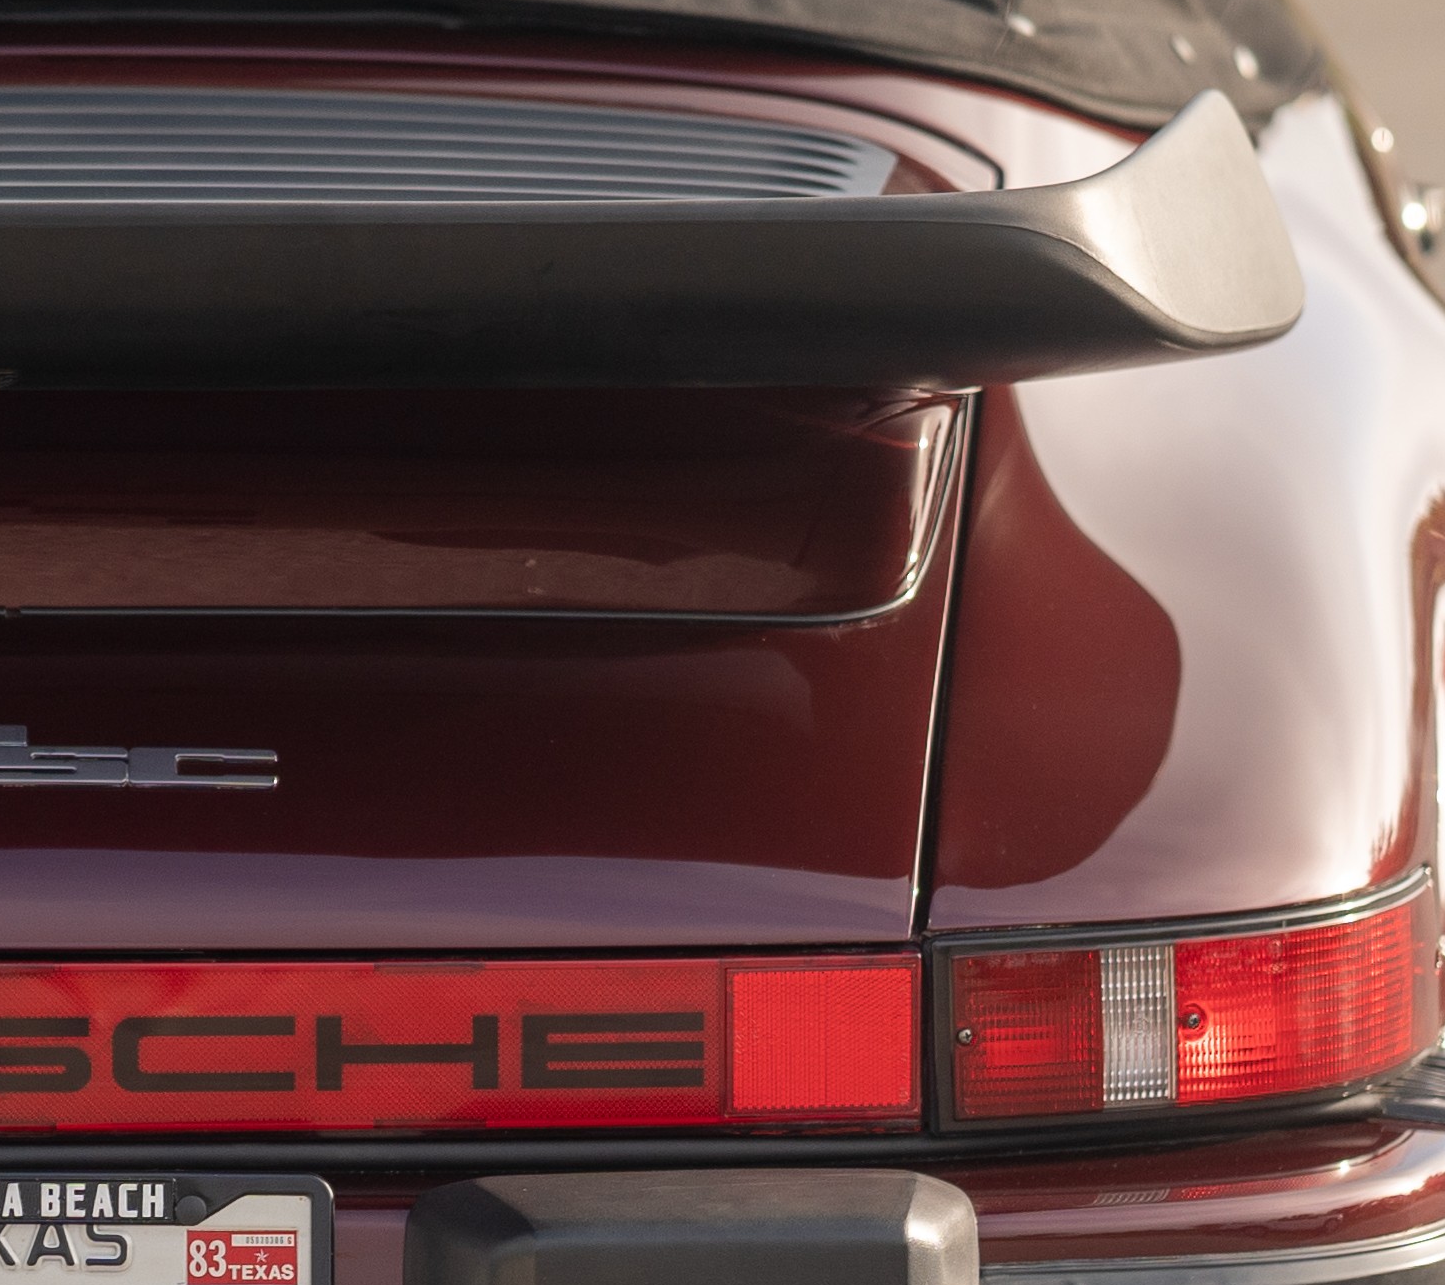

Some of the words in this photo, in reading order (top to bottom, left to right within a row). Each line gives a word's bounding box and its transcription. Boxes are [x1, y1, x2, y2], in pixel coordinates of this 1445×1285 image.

[40, 1183, 165, 1218] BEACH
[189, 1239, 227, 1277] 83
[227, 1264, 295, 1280] TEXAS
